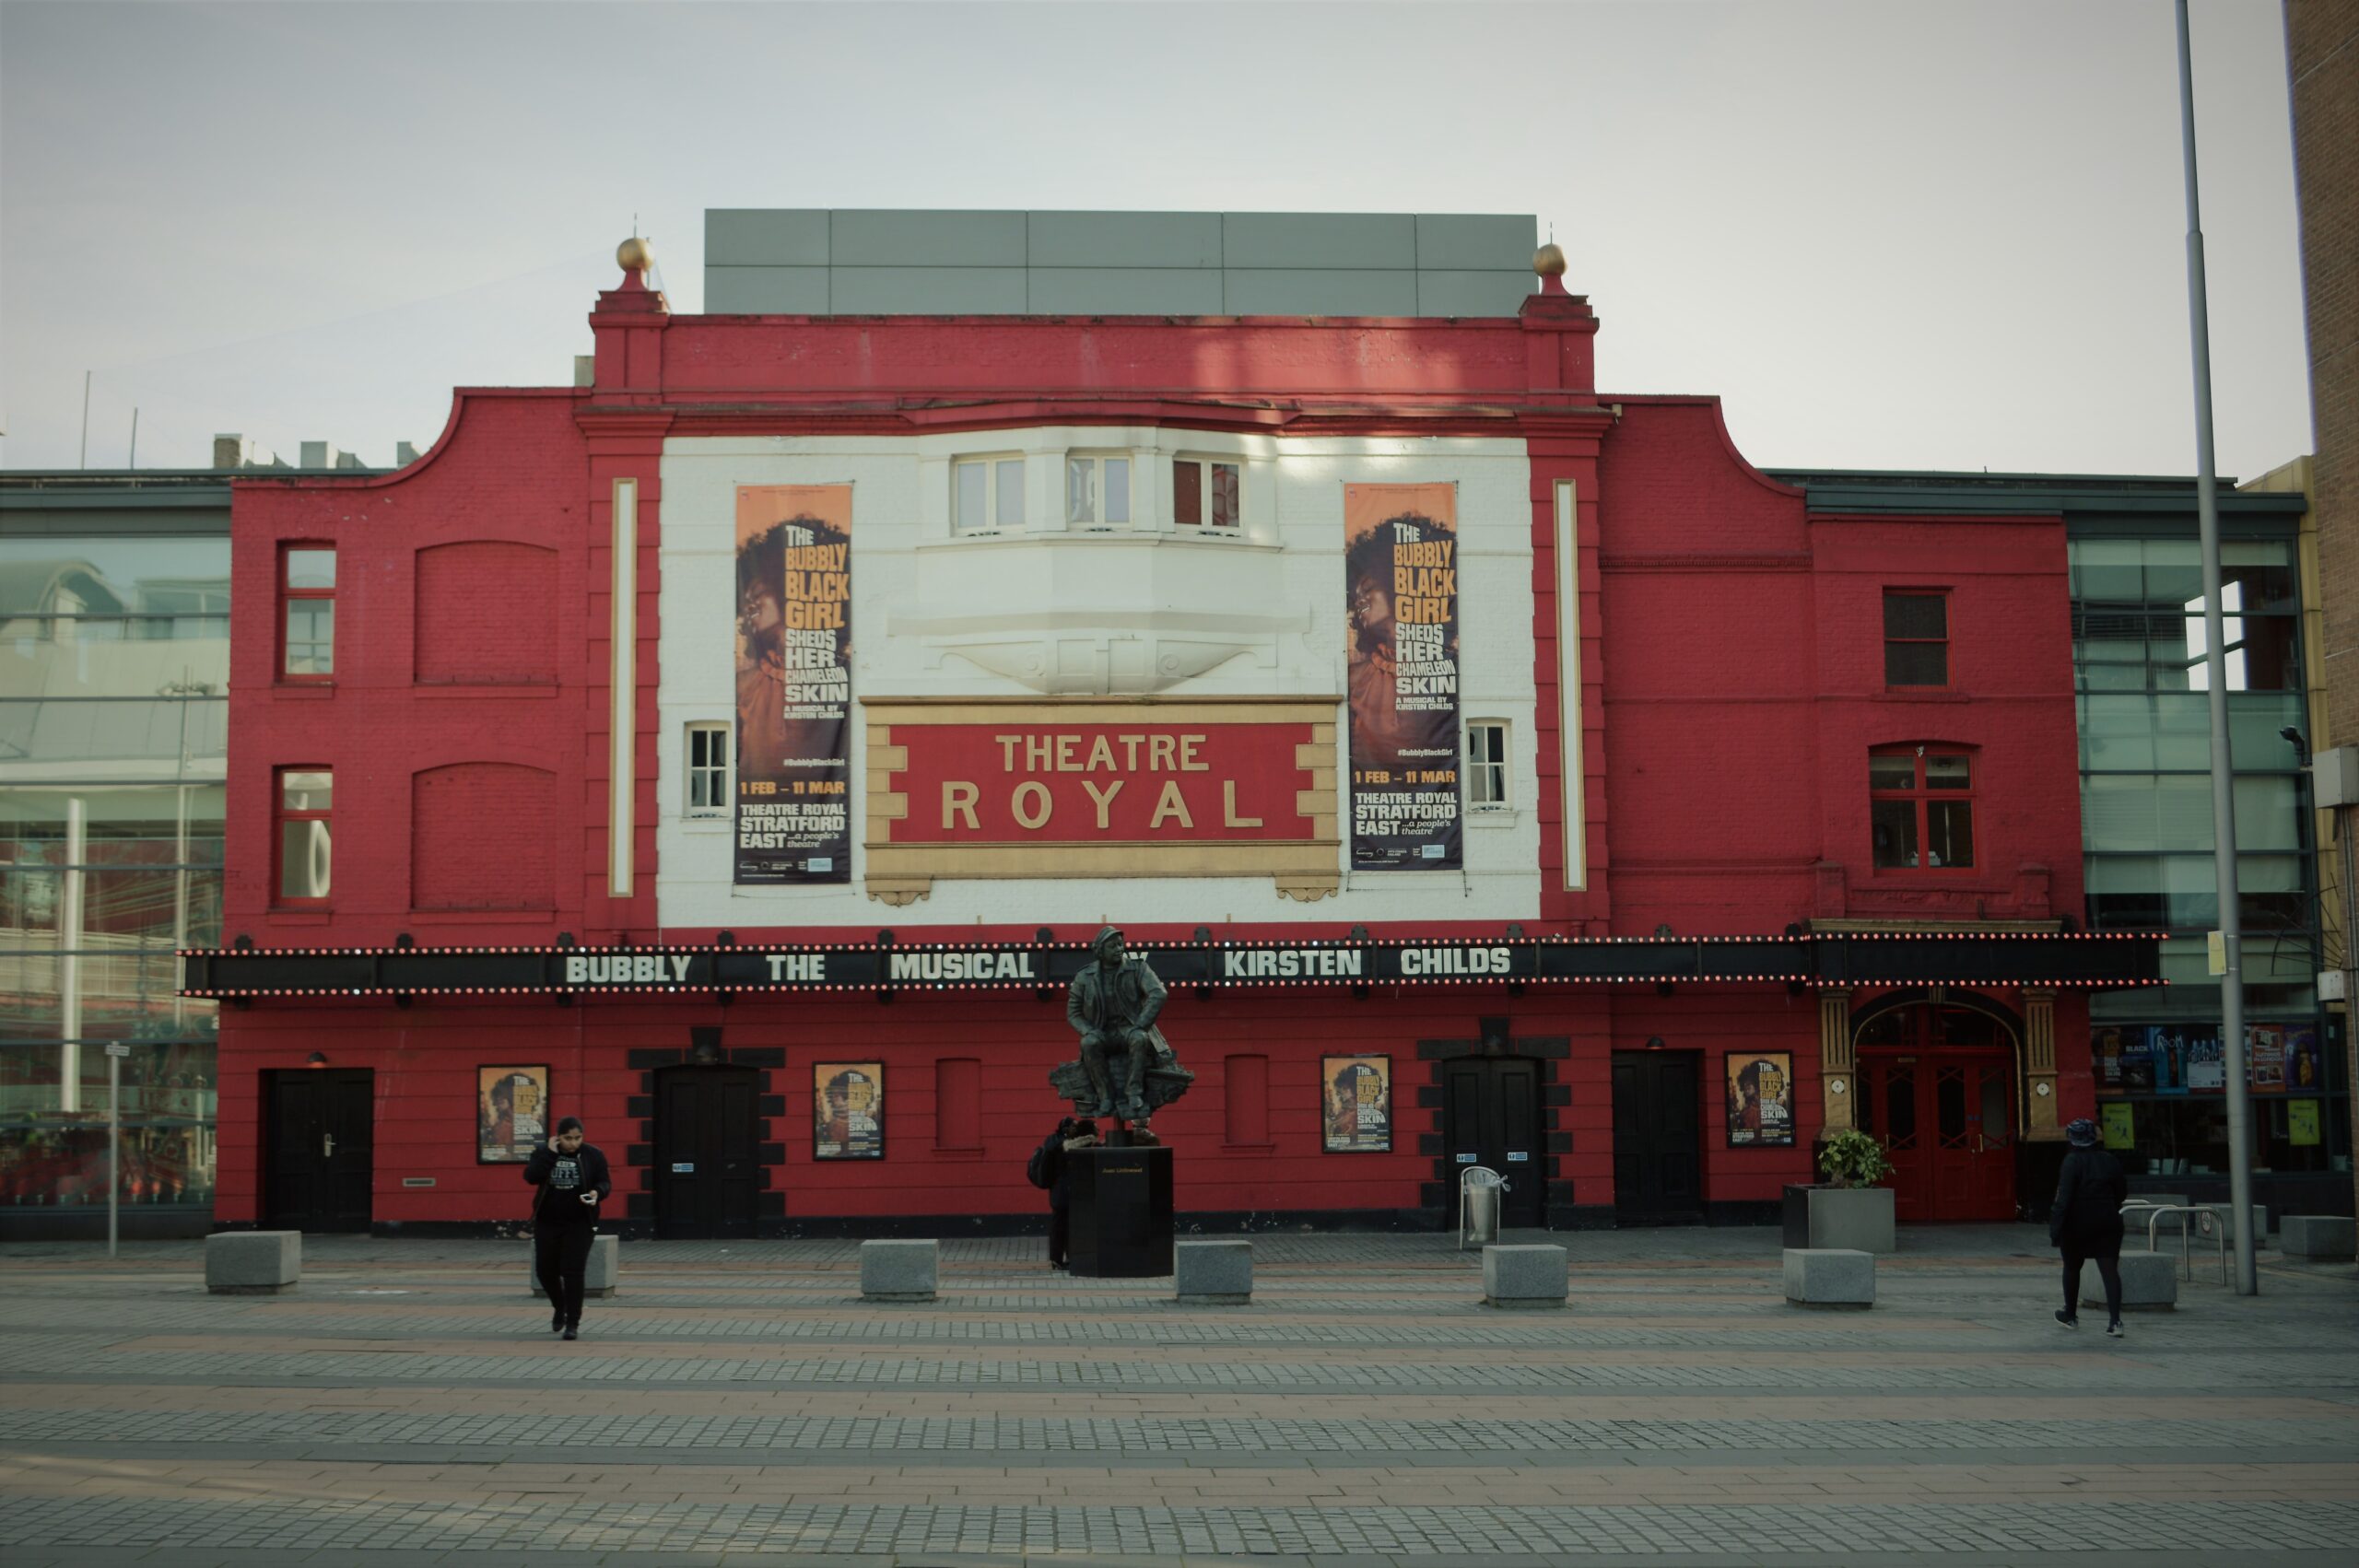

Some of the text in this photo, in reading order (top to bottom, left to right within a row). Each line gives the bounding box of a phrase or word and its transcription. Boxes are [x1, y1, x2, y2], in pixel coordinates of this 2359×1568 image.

[786, 525, 814, 546] THE
[1393, 522, 1420, 544] THE
[785, 543, 847, 571] BUBBLY
[1393, 540, 1452, 568] BUBBLY
[785, 571, 850, 603] BLACK
[1394, 567, 1457, 597] BLACK
[785, 601, 845, 630] GIRL
[1395, 595, 1451, 625] GIRL
[785, 628, 836, 651] SHEDS
[1396, 622, 1444, 645] SHEDS
[785, 647, 836, 669] HER
[1396, 640, 1444, 662] HER
[785, 666, 848, 684] CHAMELEON
[1396, 660, 1456, 677] CHAMELEON
[785, 684, 848, 702] SKIN
[1396, 675, 1456, 694] SKIN
[1428, 702, 1453, 710] CHILDS
[995, 734, 1209, 771] THEATRE
[1398, 749, 1452, 757] #BubblyBlackGirl
[1355, 771, 1361, 783] 1
[1365, 771, 1390, 783] FEB
[1406, 771, 1416, 783] 11
[1421, 771, 1456, 783] MAR
[741, 781, 747, 795] 1
[750, 781, 777, 795] FEB
[792, 781, 804, 794] 11
[808, 781, 845, 794] MAR
[942, 779, 1263, 829] ROYAL
[1355, 792, 1457, 804] THEATRE ROYAL
[740, 803, 847, 816] THEATRE ROYAL
[1356, 804, 1456, 819] STRATFORD
[740, 815, 845, 832] STRATFORD
[1356, 821, 1401, 836] EAST
[1416, 820, 1451, 829] people's
[740, 833, 787, 848] EAST
[787, 840, 820, 848] theatre
[566, 954, 691, 982] BUBBLY
[766, 954, 826, 981] THE
[890, 952, 1035, 979] MUSICAL
[1224, 949, 1362, 977] KIRSTEN
[1401, 947, 1511, 976] CHILDS
[2125, 1045, 2149, 1053] BLACK
[2157, 1035, 2184, 1053] ROOM
[1356, 1066, 1372, 1076] THE
[1758, 1062, 1774, 1071] THE
[513, 1075, 530, 1085] THE
[848, 1073, 864, 1082] THE
[1357, 1115, 1386, 1124] SKIN
[1761, 1110, 1789, 1119] SKIN
[514, 1124, 544, 1134] SKIN
[849, 1121, 877, 1131] SKIN
